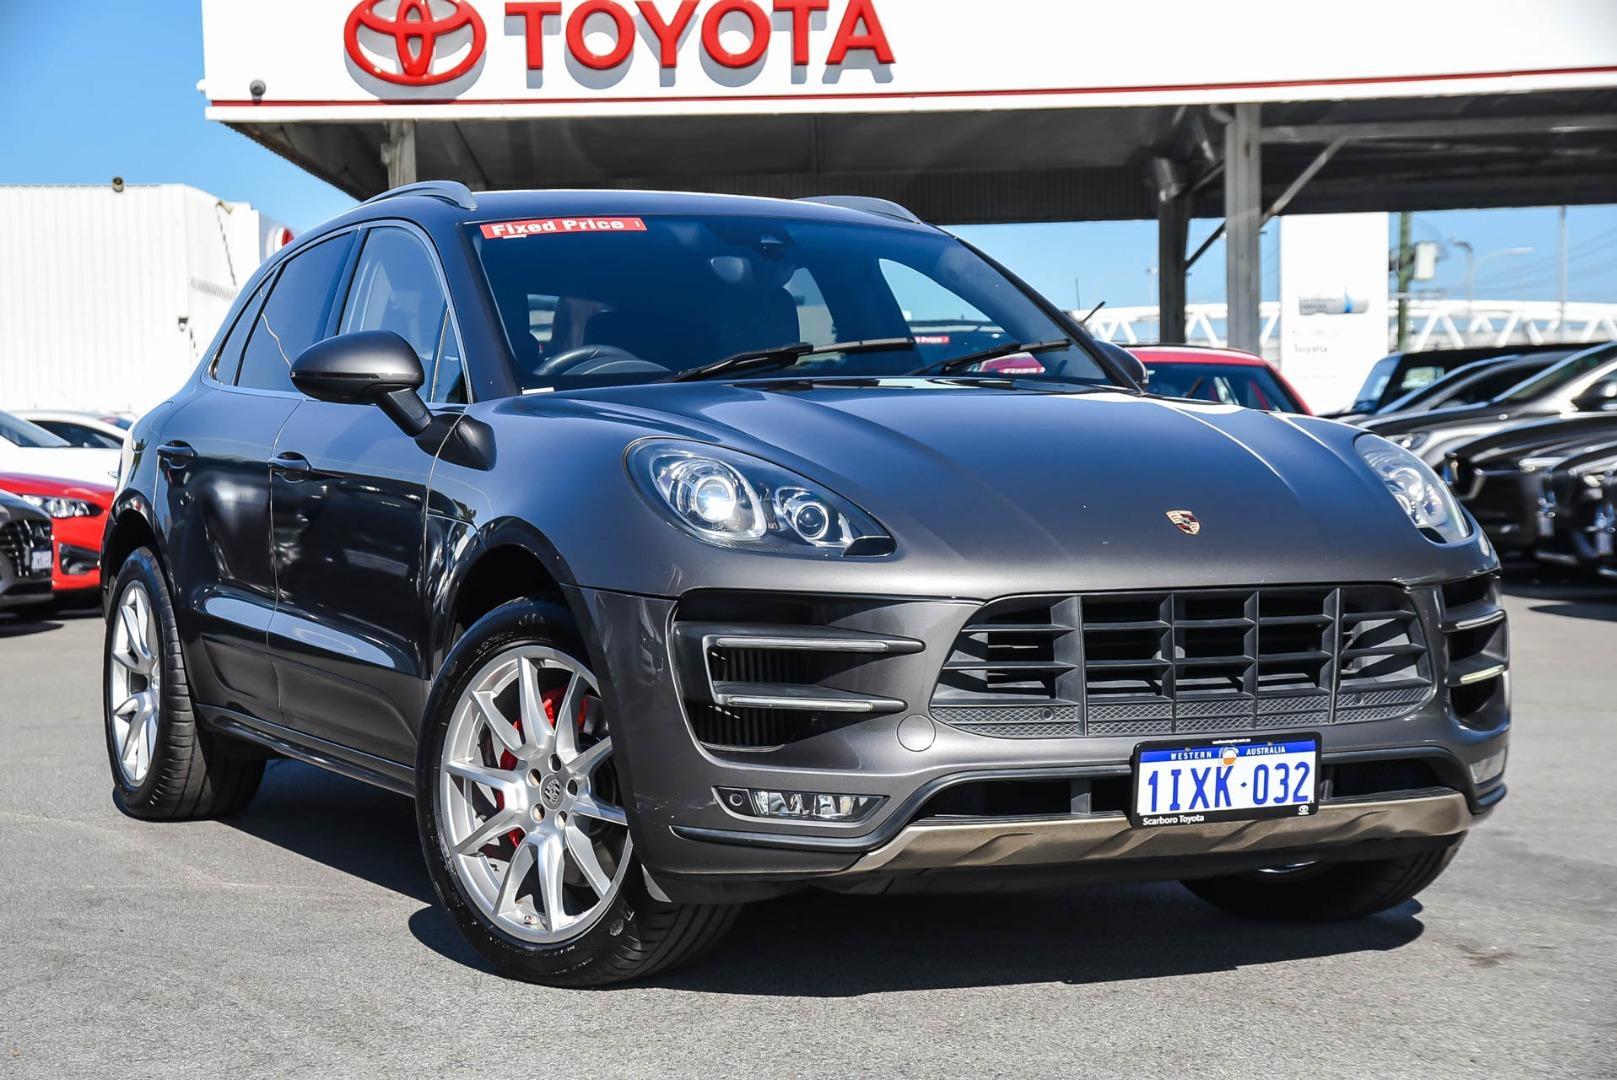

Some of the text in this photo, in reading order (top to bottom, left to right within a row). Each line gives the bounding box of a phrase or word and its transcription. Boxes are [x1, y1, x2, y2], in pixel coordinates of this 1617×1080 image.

[504, 0, 896, 71] TOYOTA
[491, 219, 624, 236] Fixed Price
[1170, 746, 1286, 761] WESTERN AUSTRALIA
[1142, 814, 1205, 826] Scarboro Toyota
